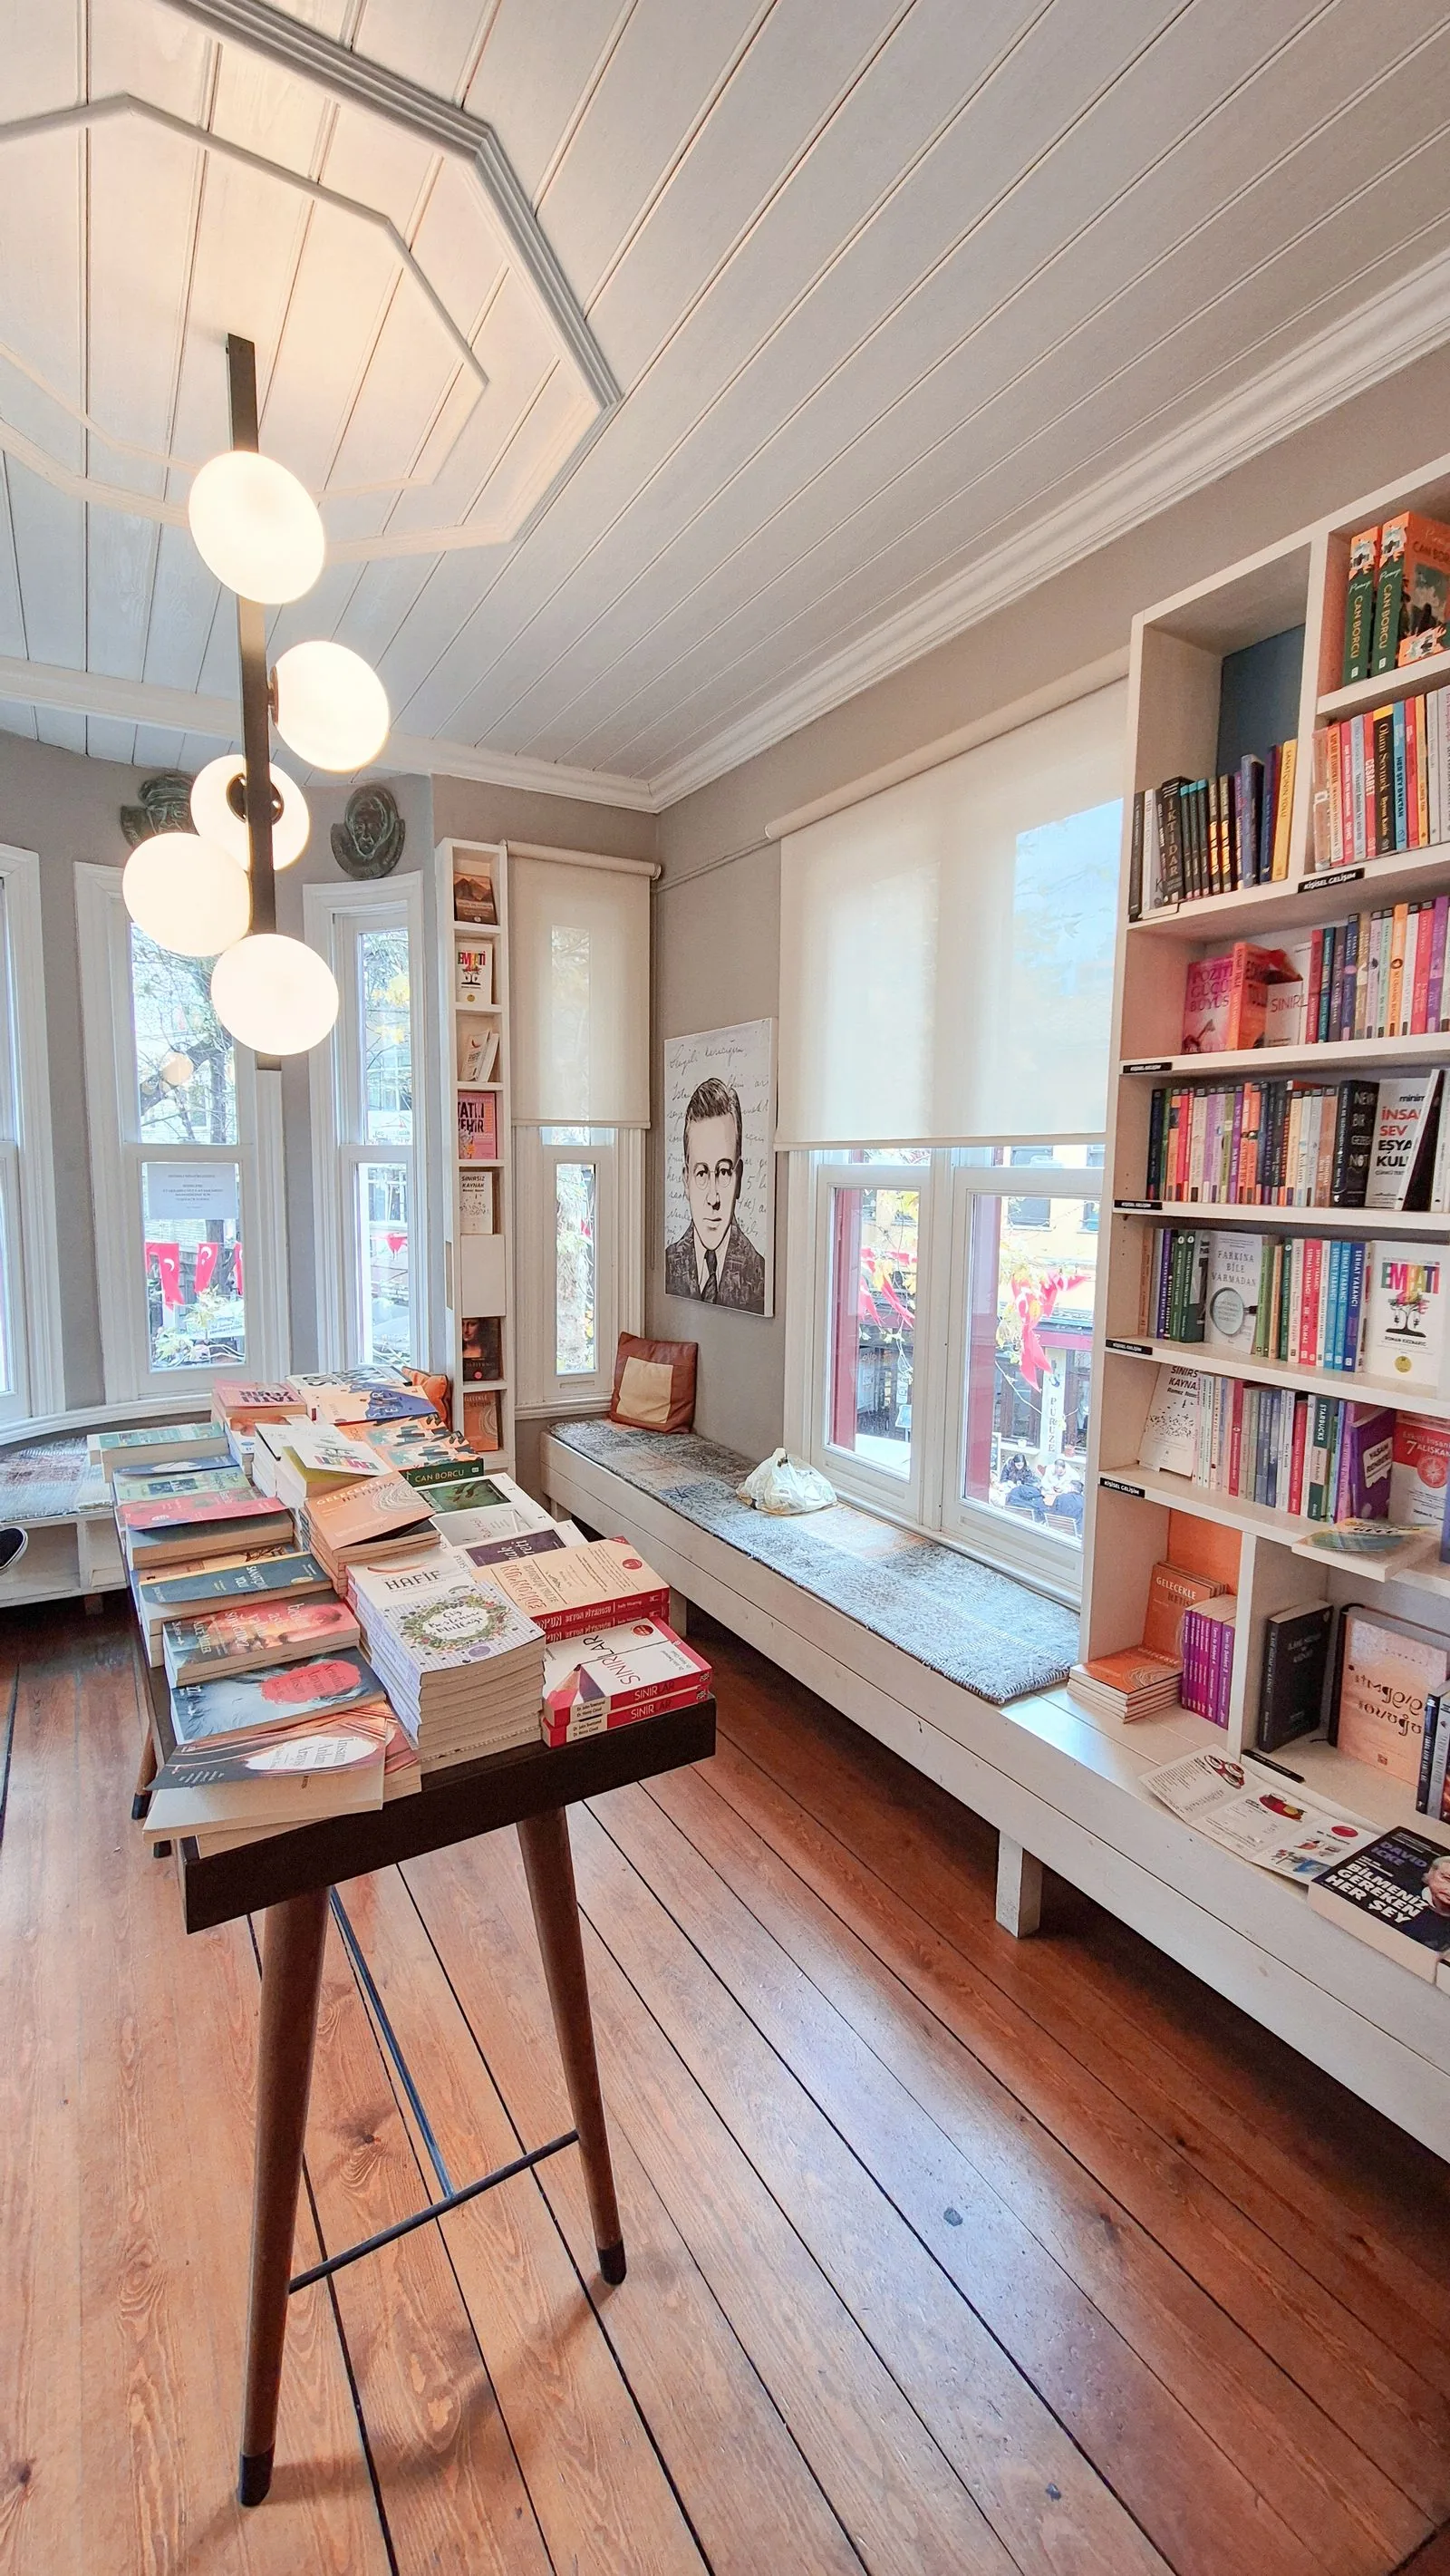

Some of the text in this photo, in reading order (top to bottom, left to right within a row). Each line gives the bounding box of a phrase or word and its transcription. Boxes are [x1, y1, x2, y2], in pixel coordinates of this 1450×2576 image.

[1365, 760, 1375, 796] CESARET
[1379, 1125, 1407, 1137] SEV
[1212, 1272, 1257, 1286] VARMADAN
[1351, 1250, 1362, 1307] SERHAT YABANCI
[1169, 1377, 1198, 1390] KAYNA
[1317, 1403, 1328, 1441] STARBUCKS
[1406, 1439, 1417, 1455] 7
[414, 1469, 465, 1484] CAN BORCU
[384, 1570, 442, 1591] HAFİF
[1155, 1576, 1197, 1601] GELECEKLE
[634, 1681, 675, 1701] SINIRLAR
[631, 1700, 672, 1719] SINIRLAR
[1337, 1869, 1421, 1918] GEREKEN
[1346, 1863, 1429, 1911] BİLMENİZ
[1325, 1874, 1412, 1923] HER ŞEY
